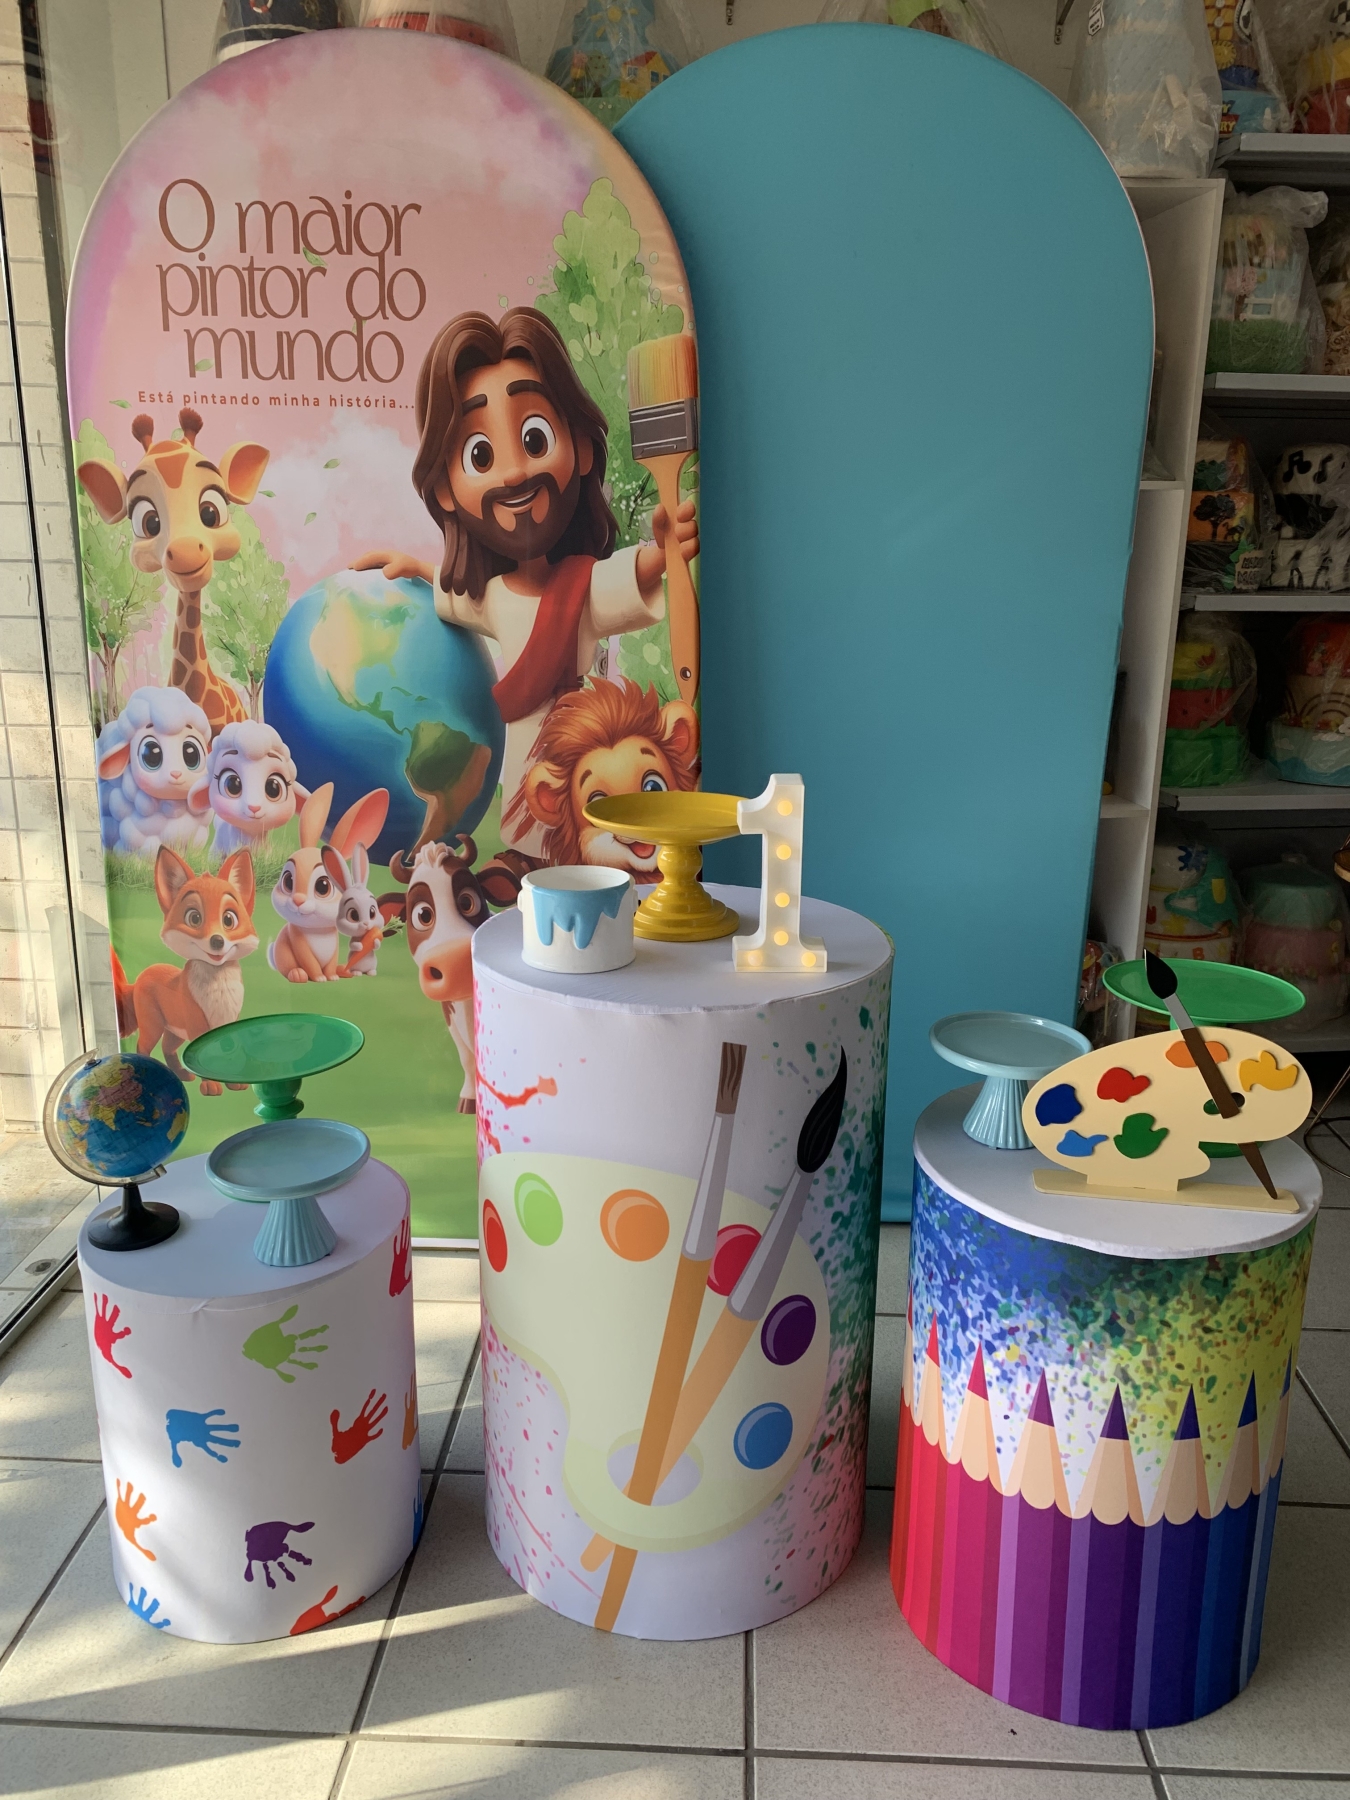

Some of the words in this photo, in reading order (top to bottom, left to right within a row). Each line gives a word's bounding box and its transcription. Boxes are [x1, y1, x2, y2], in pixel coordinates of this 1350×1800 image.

[158, 178, 216, 253] O
[235, 190, 422, 257] maior
[155, 252, 328, 332] pintor
[345, 253, 427, 322] do
[184, 318, 405, 384] mundo
[138, 390, 174, 404] Está
[183, 392, 260, 407] pintando
[269, 393, 321, 407] minha
[329, 393, 415, 410] história...
[732, 773, 828, 973] 1
